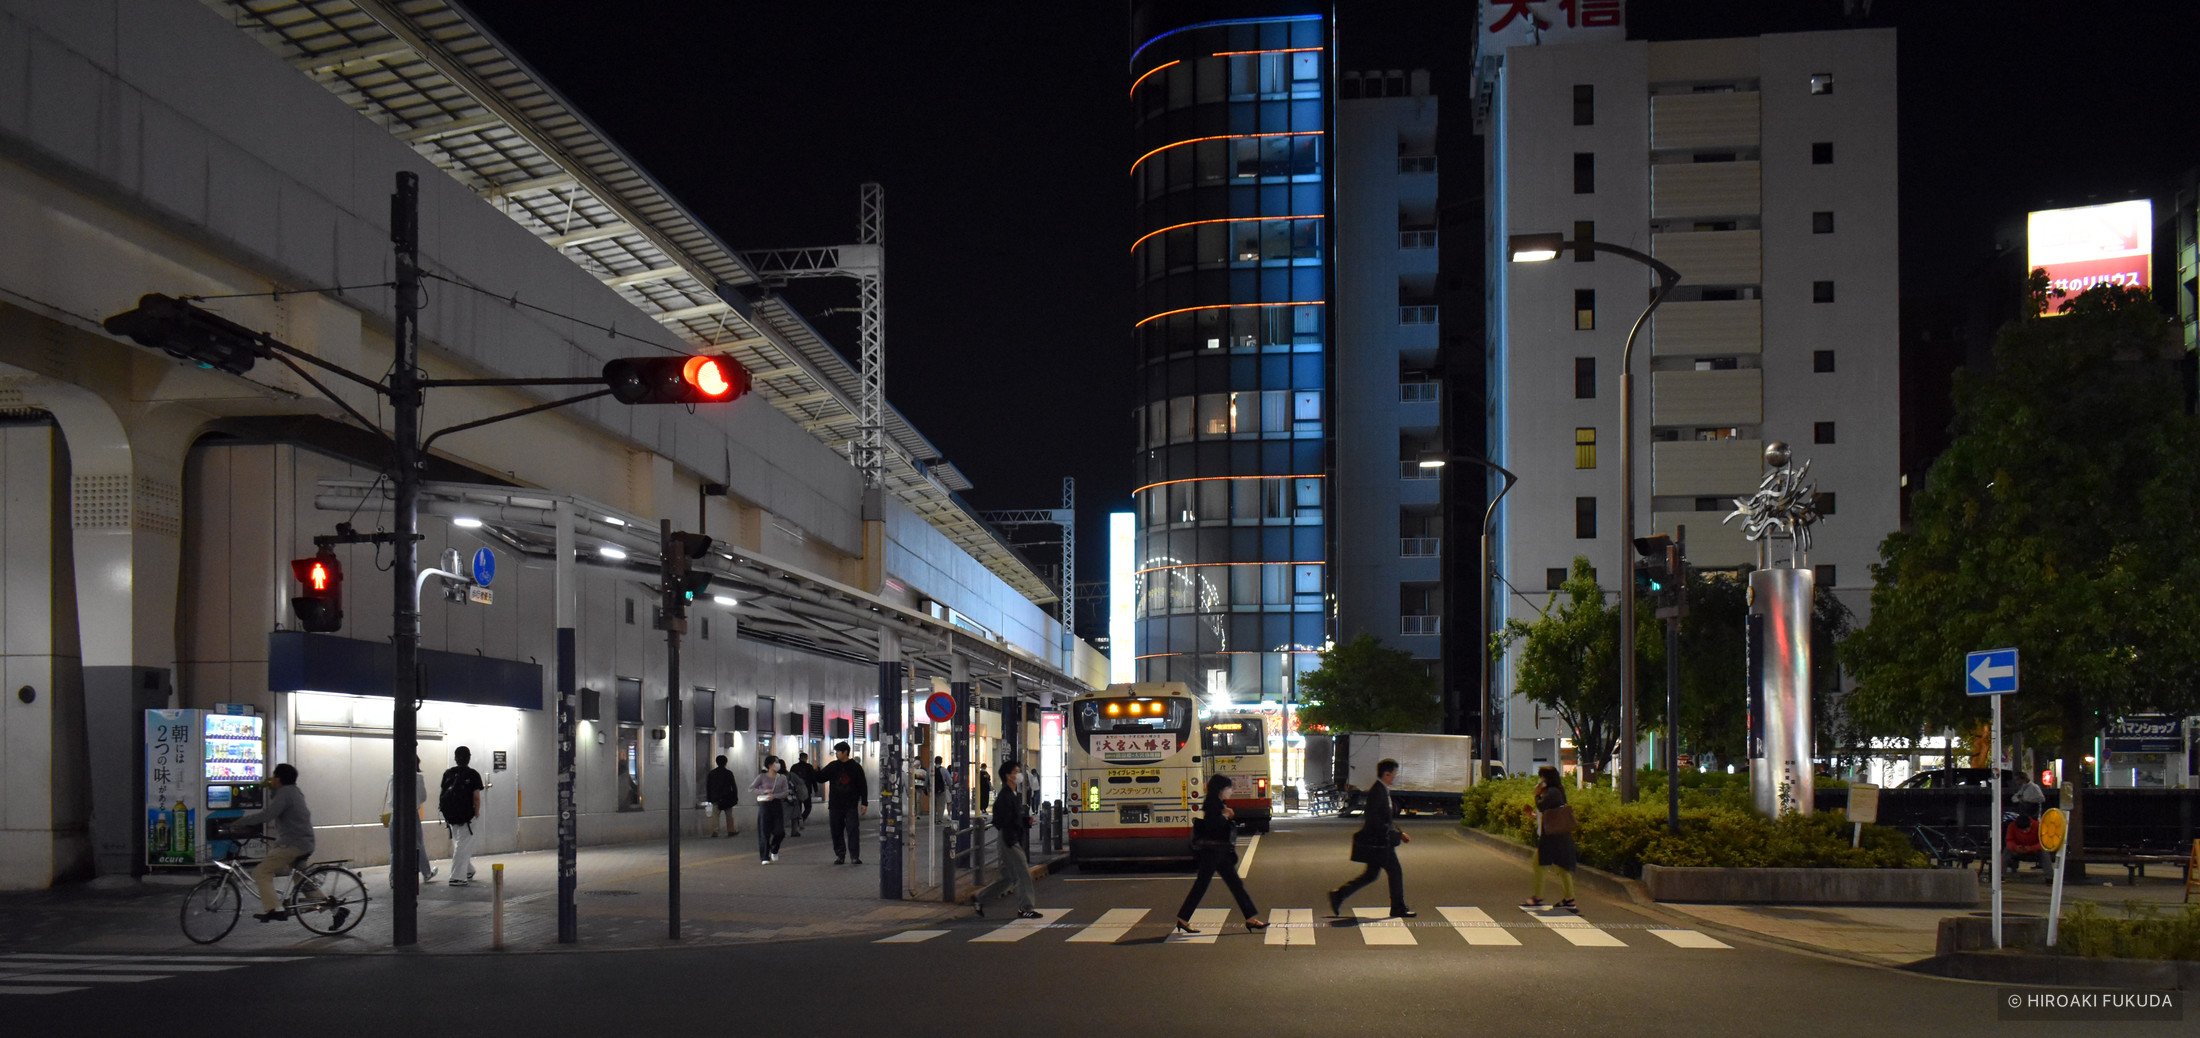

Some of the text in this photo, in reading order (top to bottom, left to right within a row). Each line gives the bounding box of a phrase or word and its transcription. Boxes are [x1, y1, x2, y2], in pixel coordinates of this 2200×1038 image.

[171, 724, 189, 764] 朝には
[1102, 739, 1171, 752] 大宮八幡宮
[154, 724, 171, 811] 2つの味がある
[1106, 786, 1163, 795] ノンステップバス
[158, 855, 185, 863] acure
